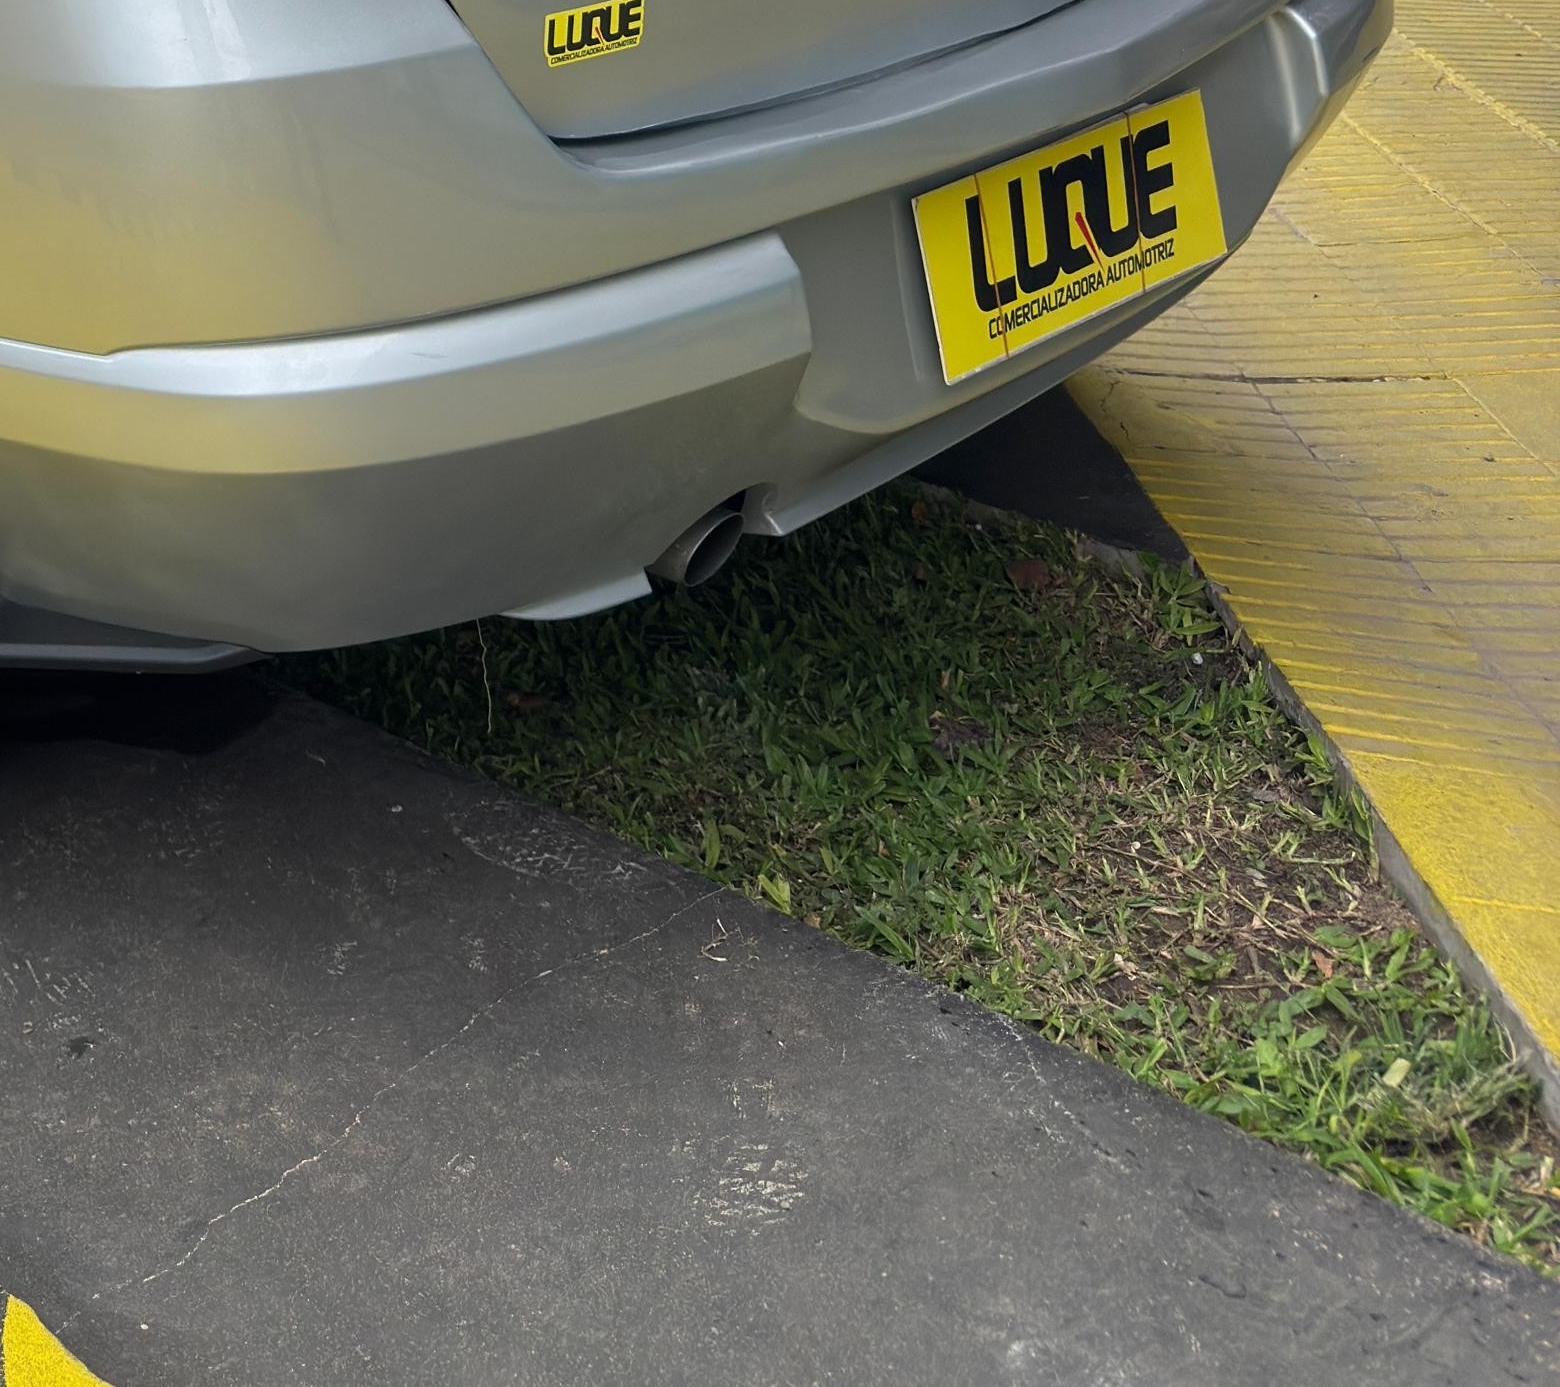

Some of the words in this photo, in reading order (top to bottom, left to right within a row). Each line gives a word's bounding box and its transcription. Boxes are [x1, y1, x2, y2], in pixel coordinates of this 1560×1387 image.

[550, 45, 605, 65] COMERCIALIZADORA
[605, 36, 638, 52] AUTOMOTRIZ
[964, 119, 1178, 313] LUQUE
[987, 273, 1105, 340] COMERCIALIZADORA
[1105, 237, 1175, 285] AUTOMOTRIZ
